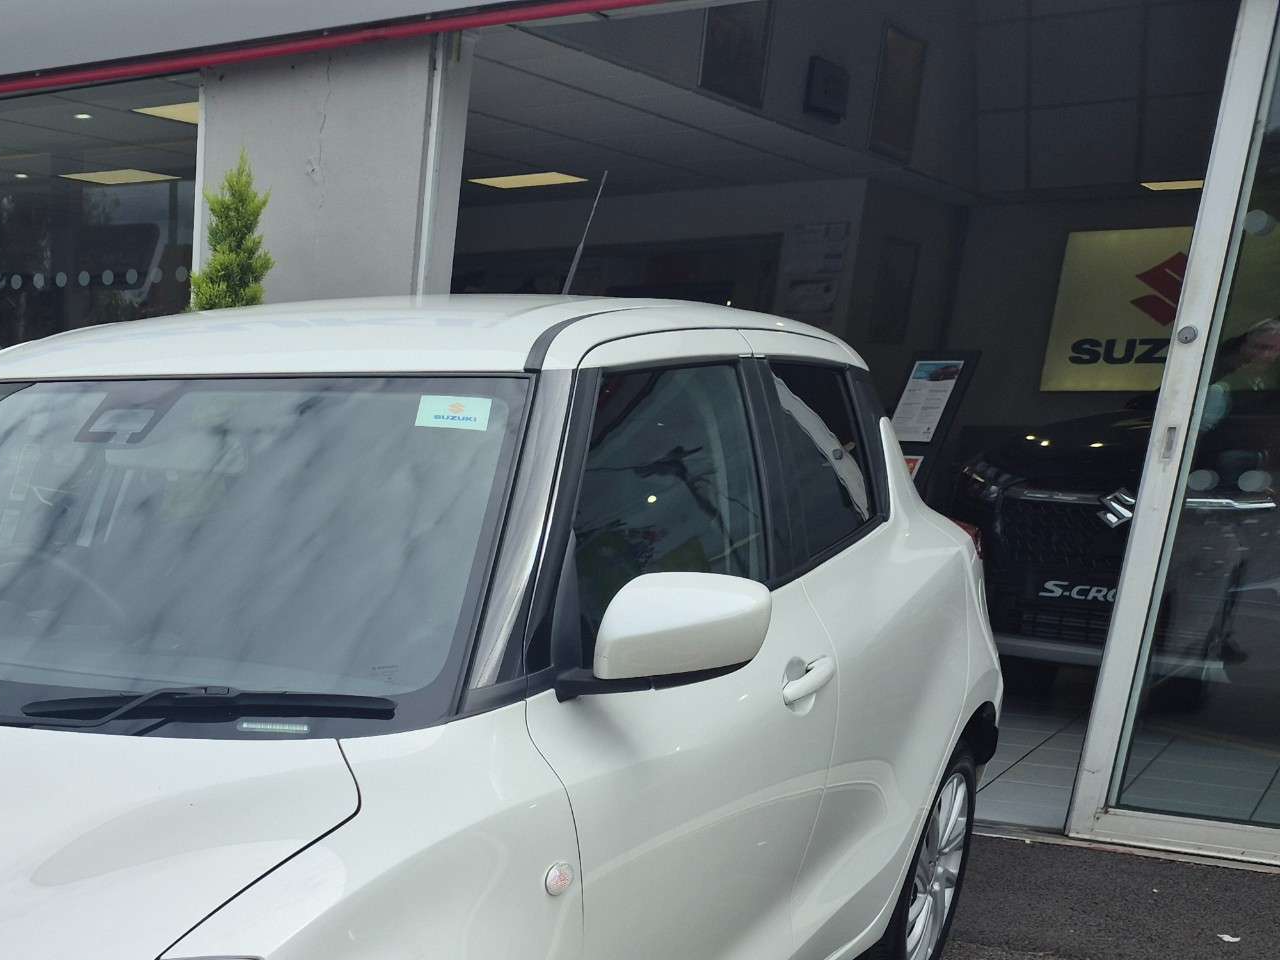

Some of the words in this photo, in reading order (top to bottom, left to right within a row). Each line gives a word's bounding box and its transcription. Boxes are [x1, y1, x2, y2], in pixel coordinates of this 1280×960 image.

[1068, 338, 1170, 364] SUZ
[433, 414, 477, 422] SUZUKI
[1038, 580, 1117, 602] S-CRO
